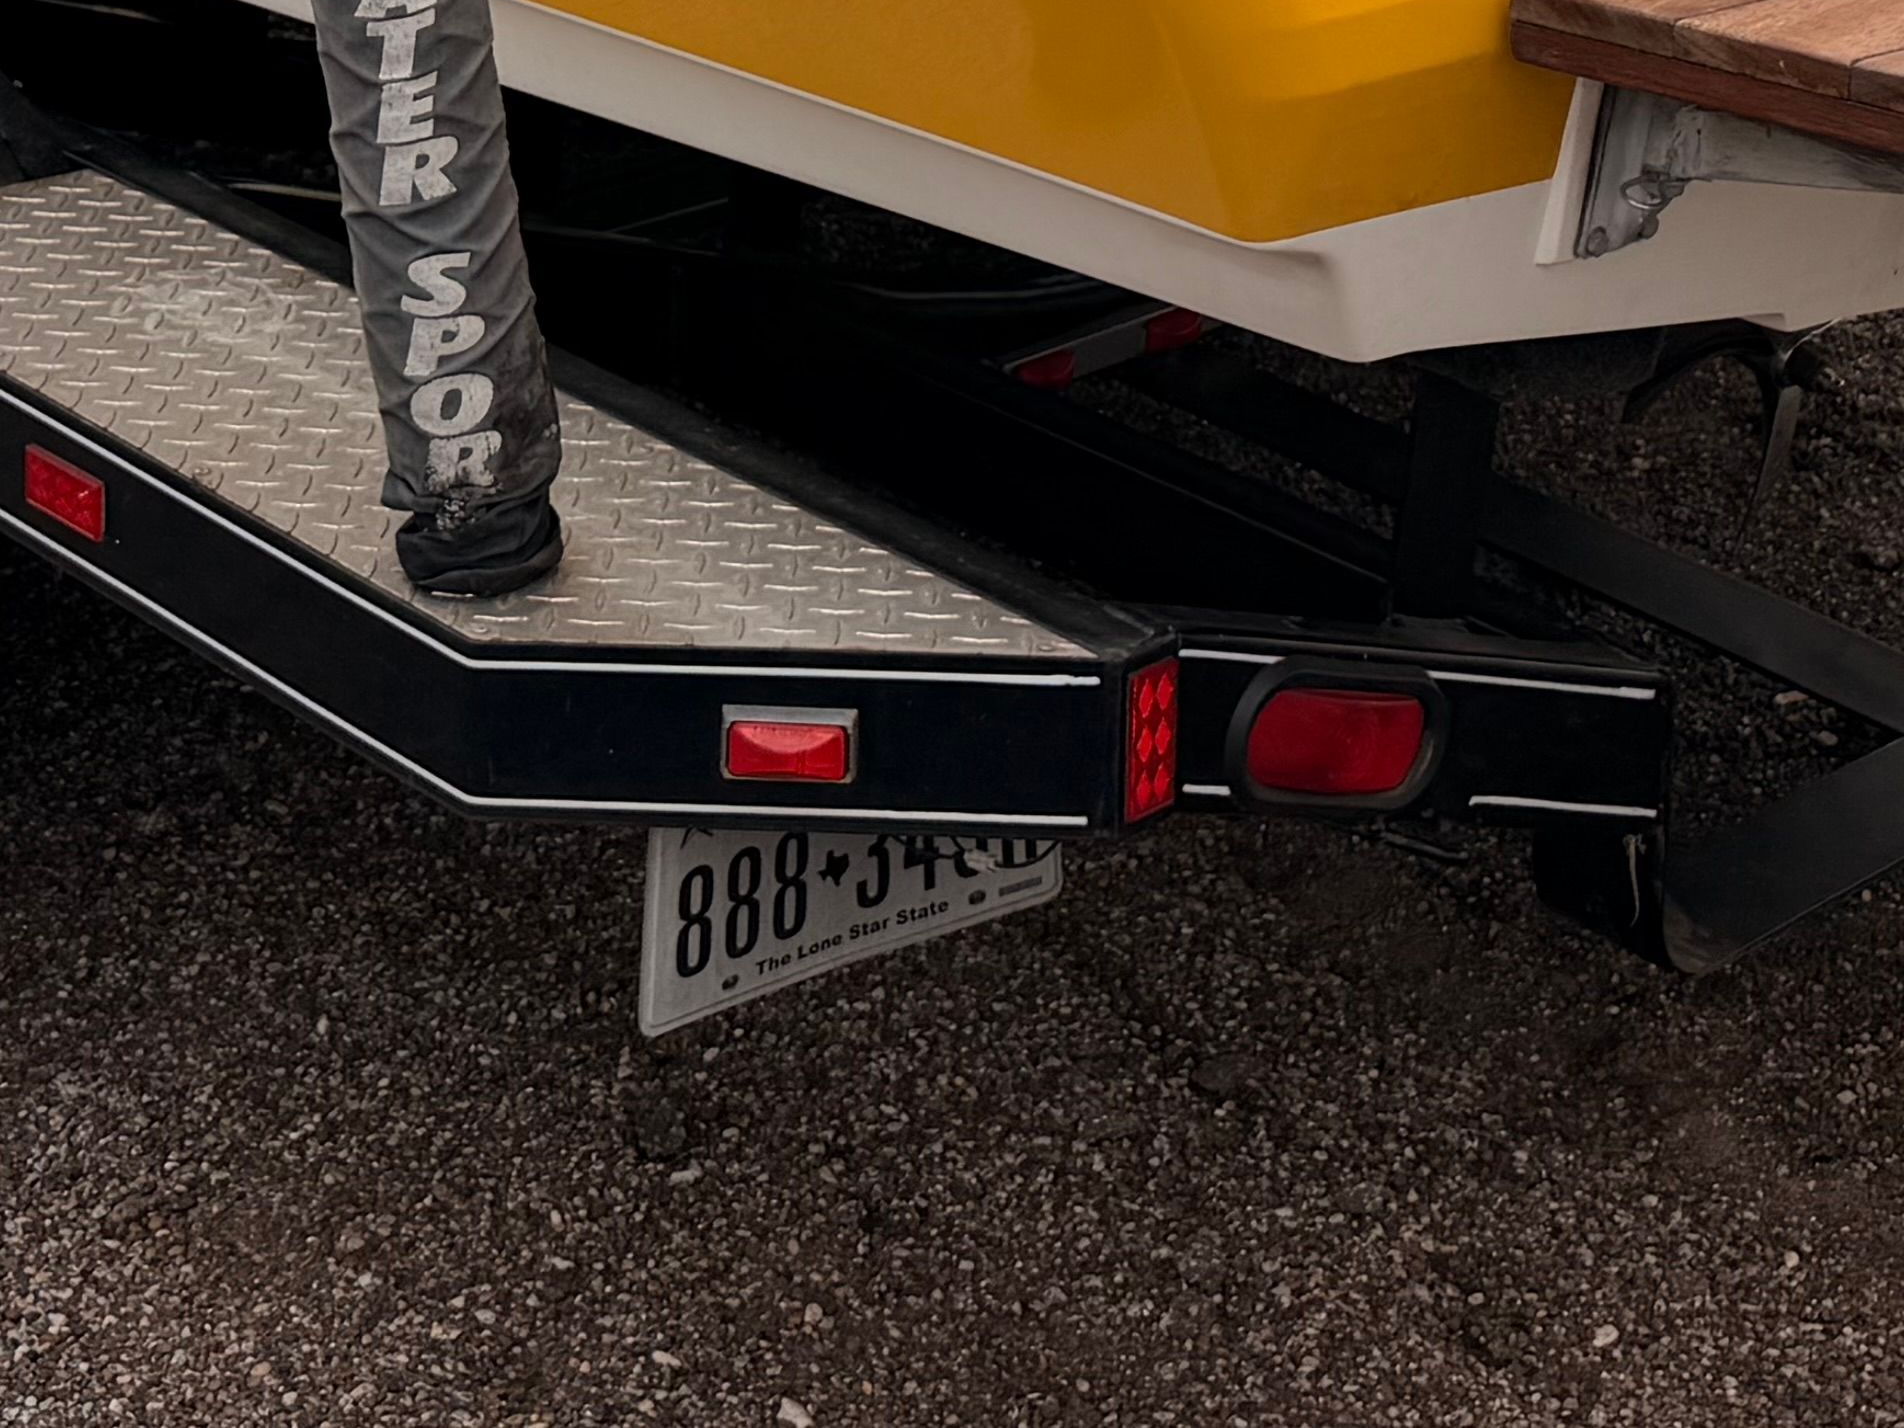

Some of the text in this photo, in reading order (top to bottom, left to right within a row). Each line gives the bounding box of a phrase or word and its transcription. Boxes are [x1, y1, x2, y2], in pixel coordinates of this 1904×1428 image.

[400, 251, 503, 531] SPOR
[675, 832, 810, 978] 888
[755, 900, 950, 977] The Lone Star State
